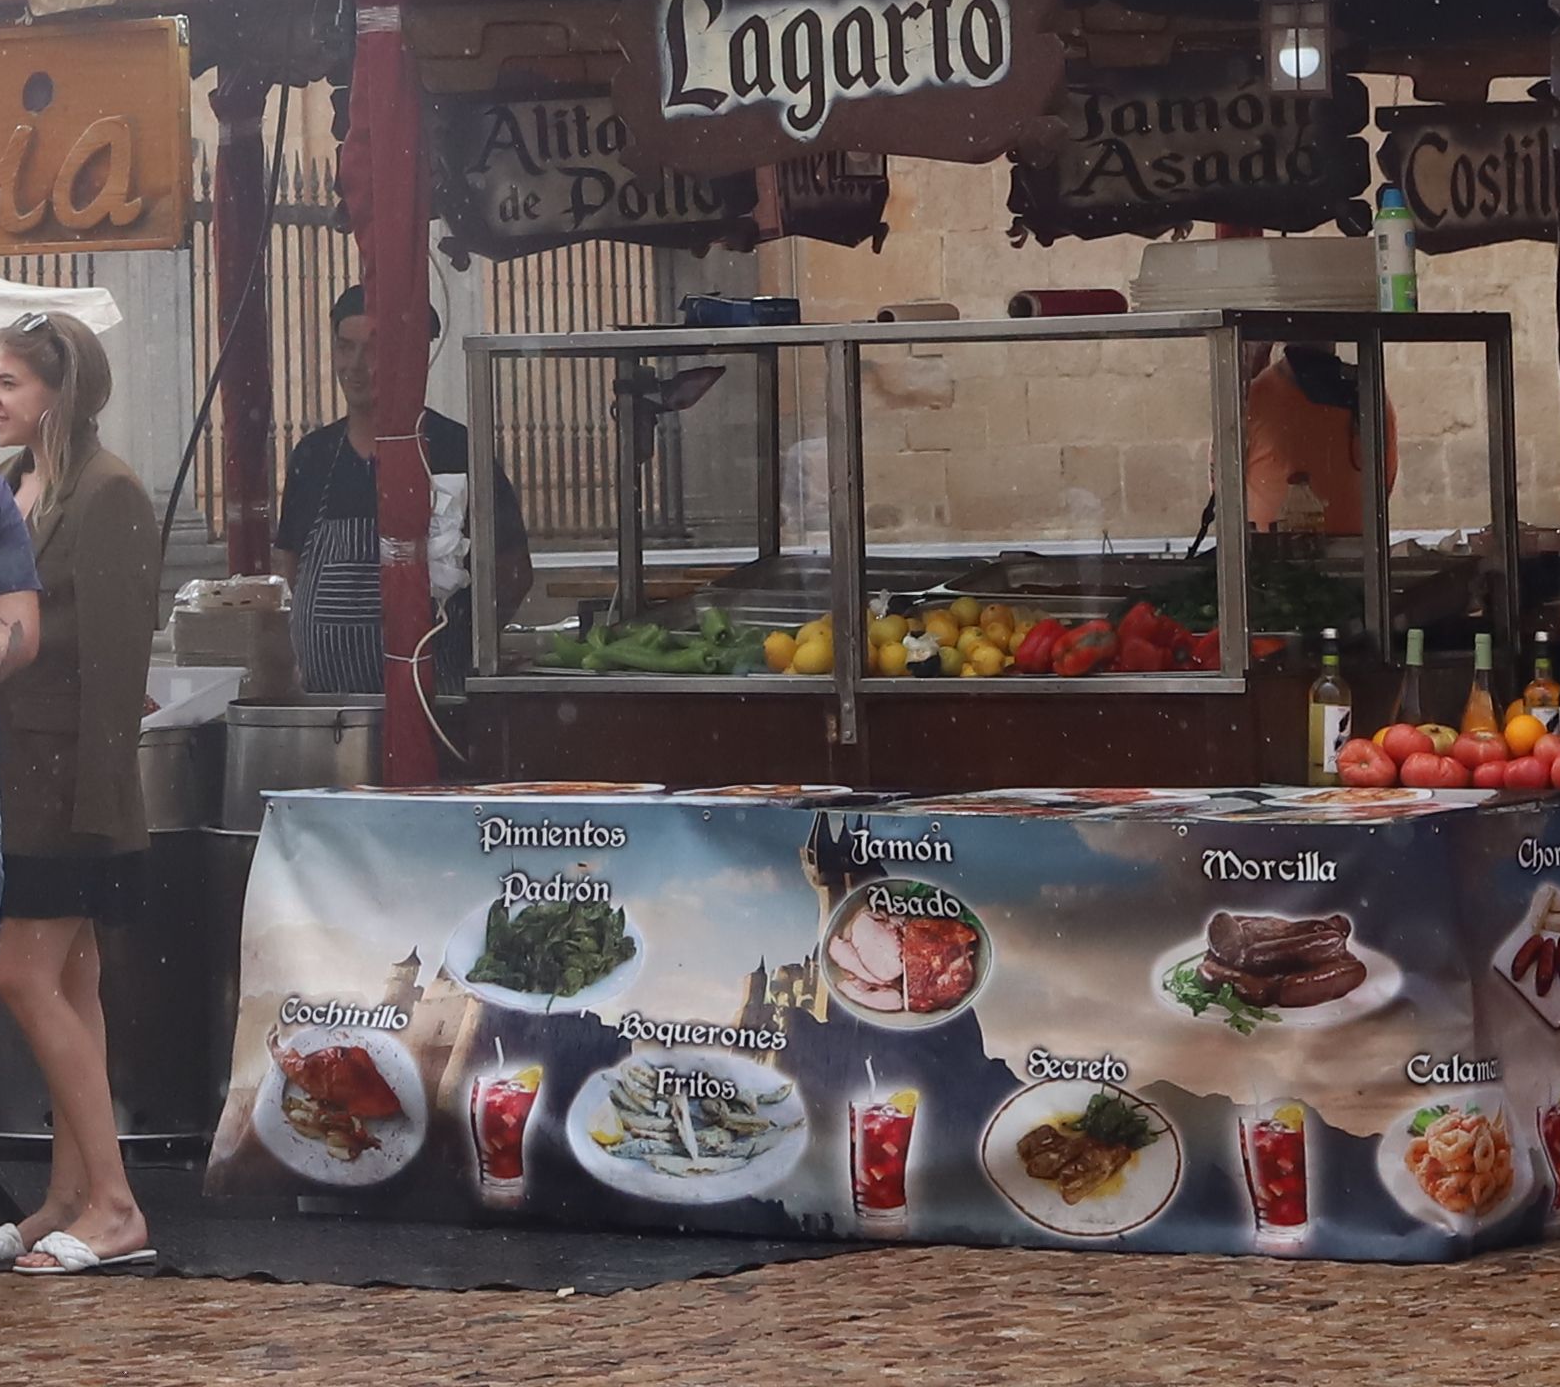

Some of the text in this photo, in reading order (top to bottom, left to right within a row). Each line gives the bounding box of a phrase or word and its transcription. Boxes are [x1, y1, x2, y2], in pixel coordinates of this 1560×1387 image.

[467, 106, 627, 176] Alita
[1068, 127, 1327, 201] Asado
[1403, 126, 1554, 227] Costil
[499, 185, 541, 223] de
[479, 816, 627, 853] Pimientos
[849, 828, 954, 864] Jamón
[1202, 849, 1337, 883] Morcilla
[500, 871, 610, 907] Padrón
[866, 884, 962, 918] Asado
[280, 997, 409, 1032] Cochinillo
[655, 1066, 737, 1100] Fritos
[1027, 1049, 1128, 1083] Secreto
[1406, 1052, 1501, 1084] Calama
